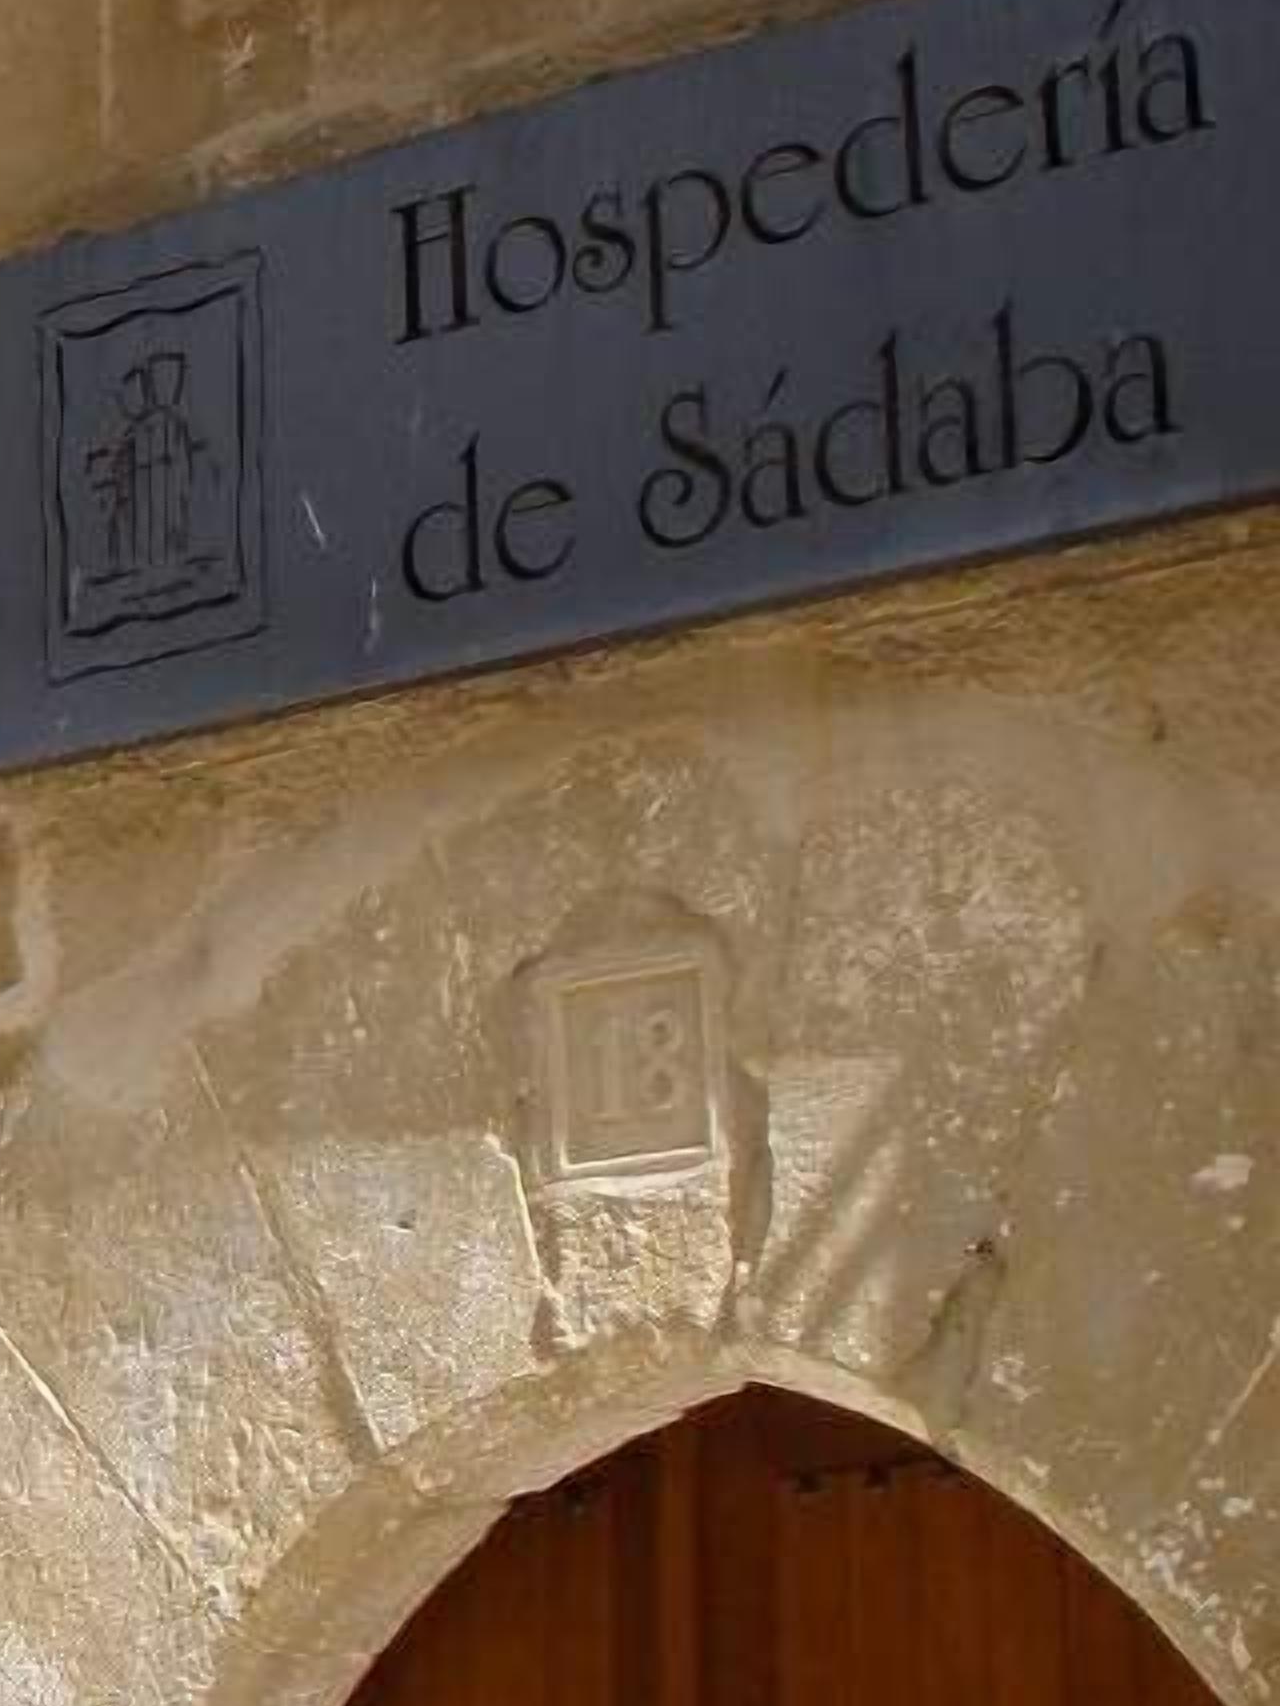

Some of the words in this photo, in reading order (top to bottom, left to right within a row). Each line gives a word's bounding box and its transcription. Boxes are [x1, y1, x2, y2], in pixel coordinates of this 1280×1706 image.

[401, 430, 576, 602] de
[638, 296, 1185, 548] Sádaba
[589, 1008, 684, 1119] 18
